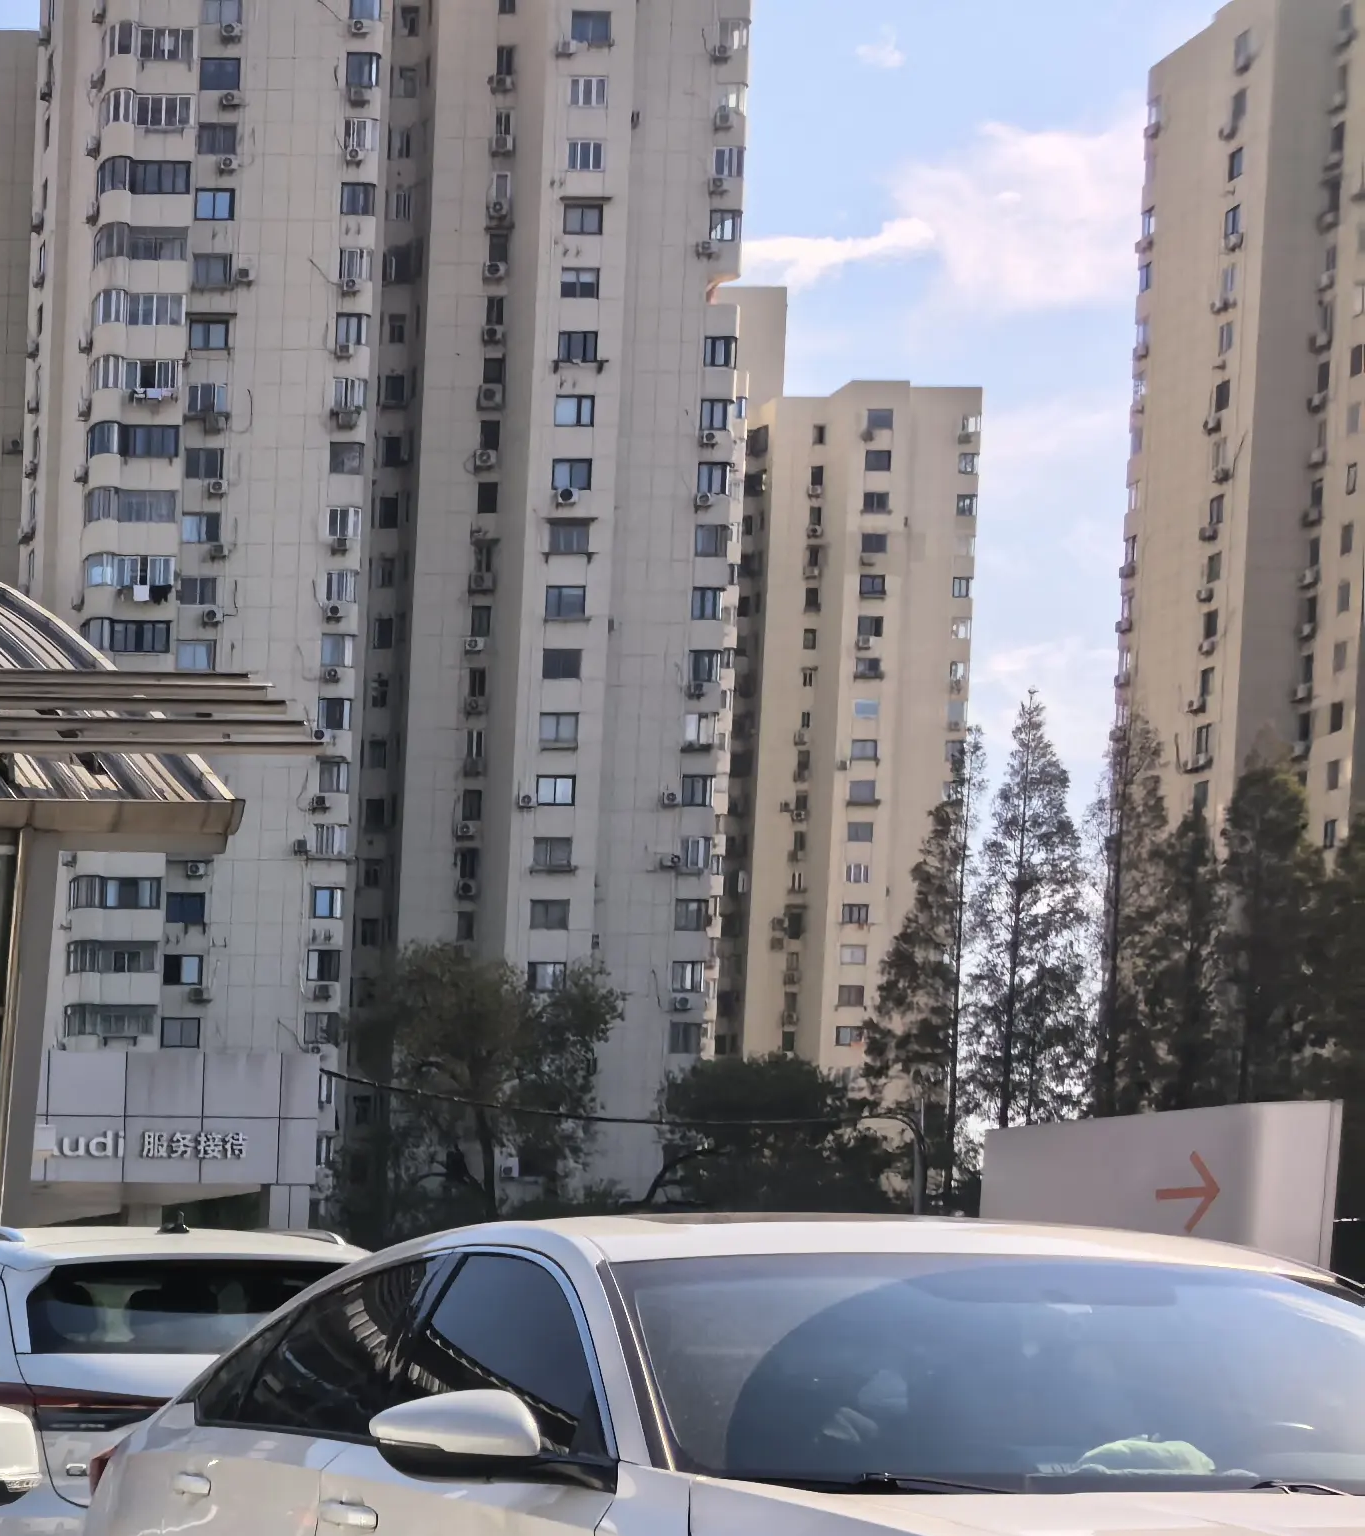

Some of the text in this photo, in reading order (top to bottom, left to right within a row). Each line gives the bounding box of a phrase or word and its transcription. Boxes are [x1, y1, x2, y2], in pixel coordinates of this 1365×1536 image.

[52, 1129, 248, 1159] udi 服务接待
